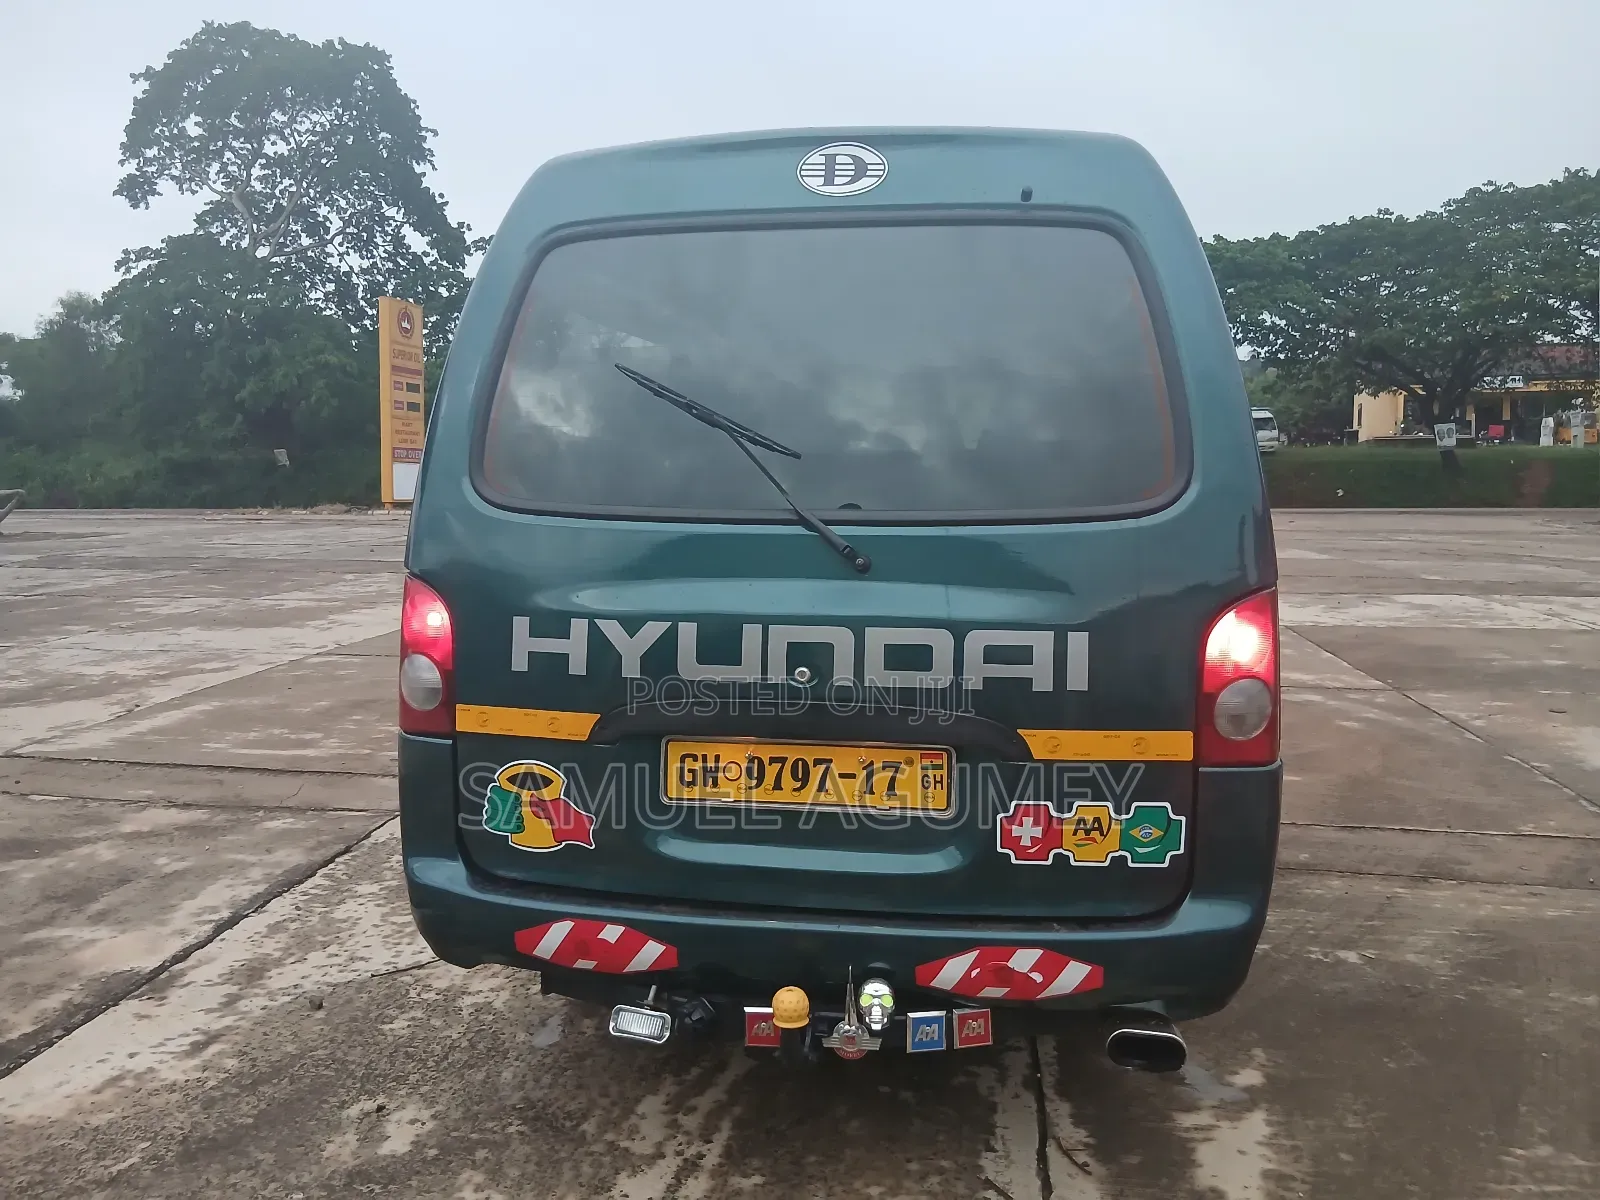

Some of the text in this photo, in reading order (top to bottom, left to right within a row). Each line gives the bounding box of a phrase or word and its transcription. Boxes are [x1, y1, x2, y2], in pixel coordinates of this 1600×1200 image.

[392, 348, 413, 361] SUPERIOR
[394, 449, 407, 458] STOP
[511, 616, 1089, 691] HYUNDAI
[745, 755, 903, 797] 9797-17
[921, 773, 944, 790] GH
[1072, 817, 1105, 836] AA
